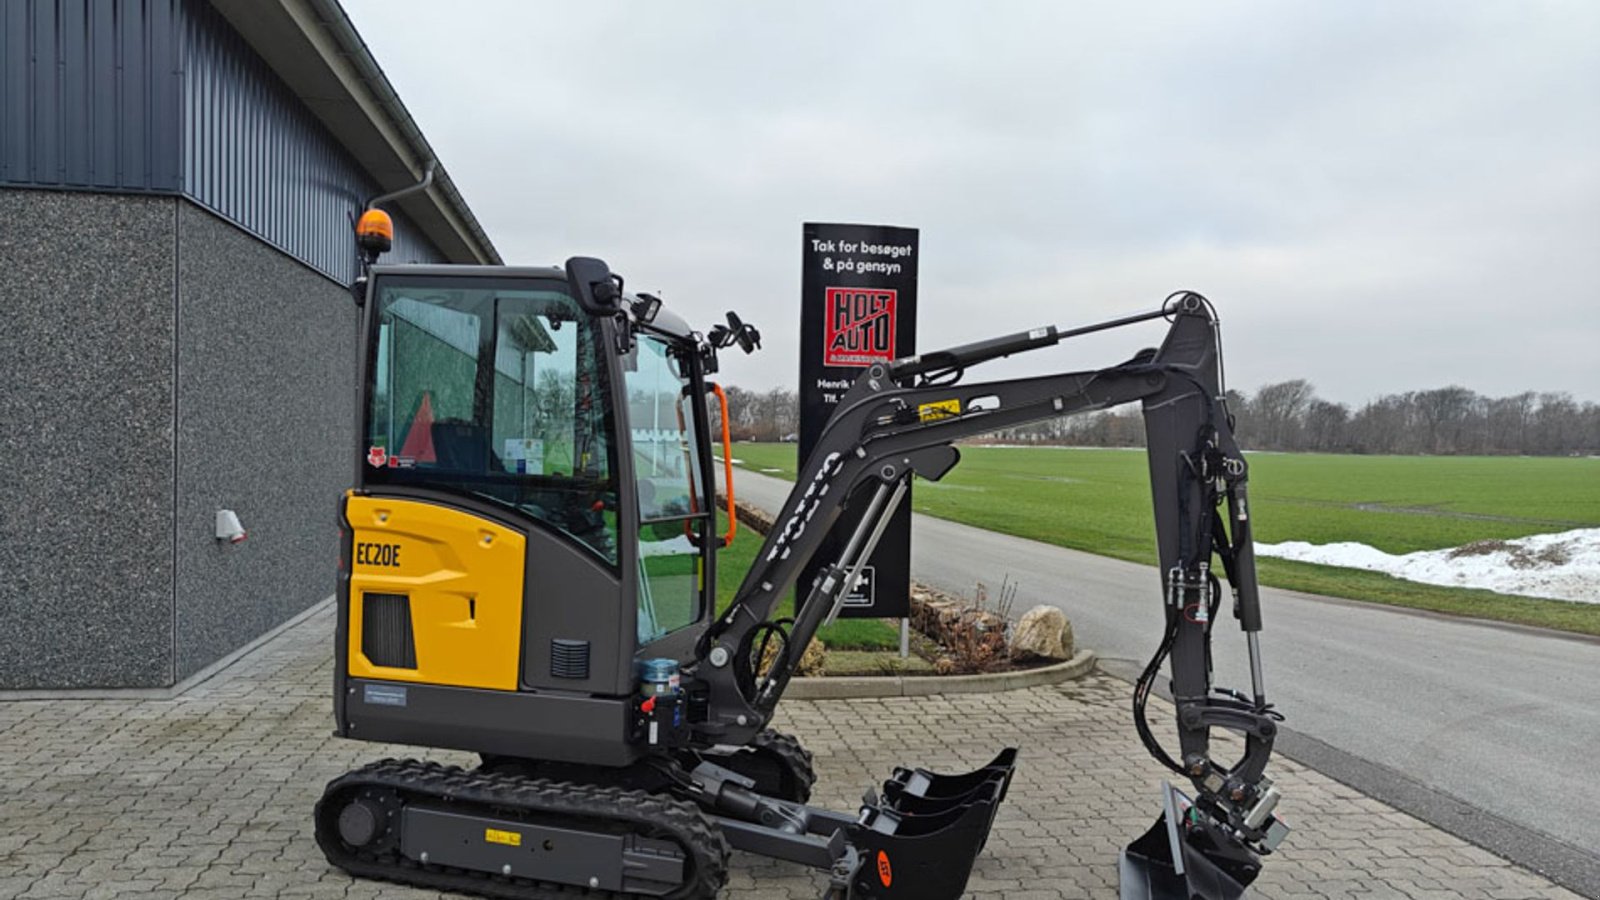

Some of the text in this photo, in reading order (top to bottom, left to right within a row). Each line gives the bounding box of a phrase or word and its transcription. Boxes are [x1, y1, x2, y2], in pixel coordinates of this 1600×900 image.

[812, 239, 912, 258] Tak for besøget
[823, 257, 901, 275] & på gensyn
[834, 293, 890, 331] HOLT
[830, 312, 890, 351] AUTO
[817, 379, 850, 389] Henrik
[357, 543, 401, 567] EC20E
